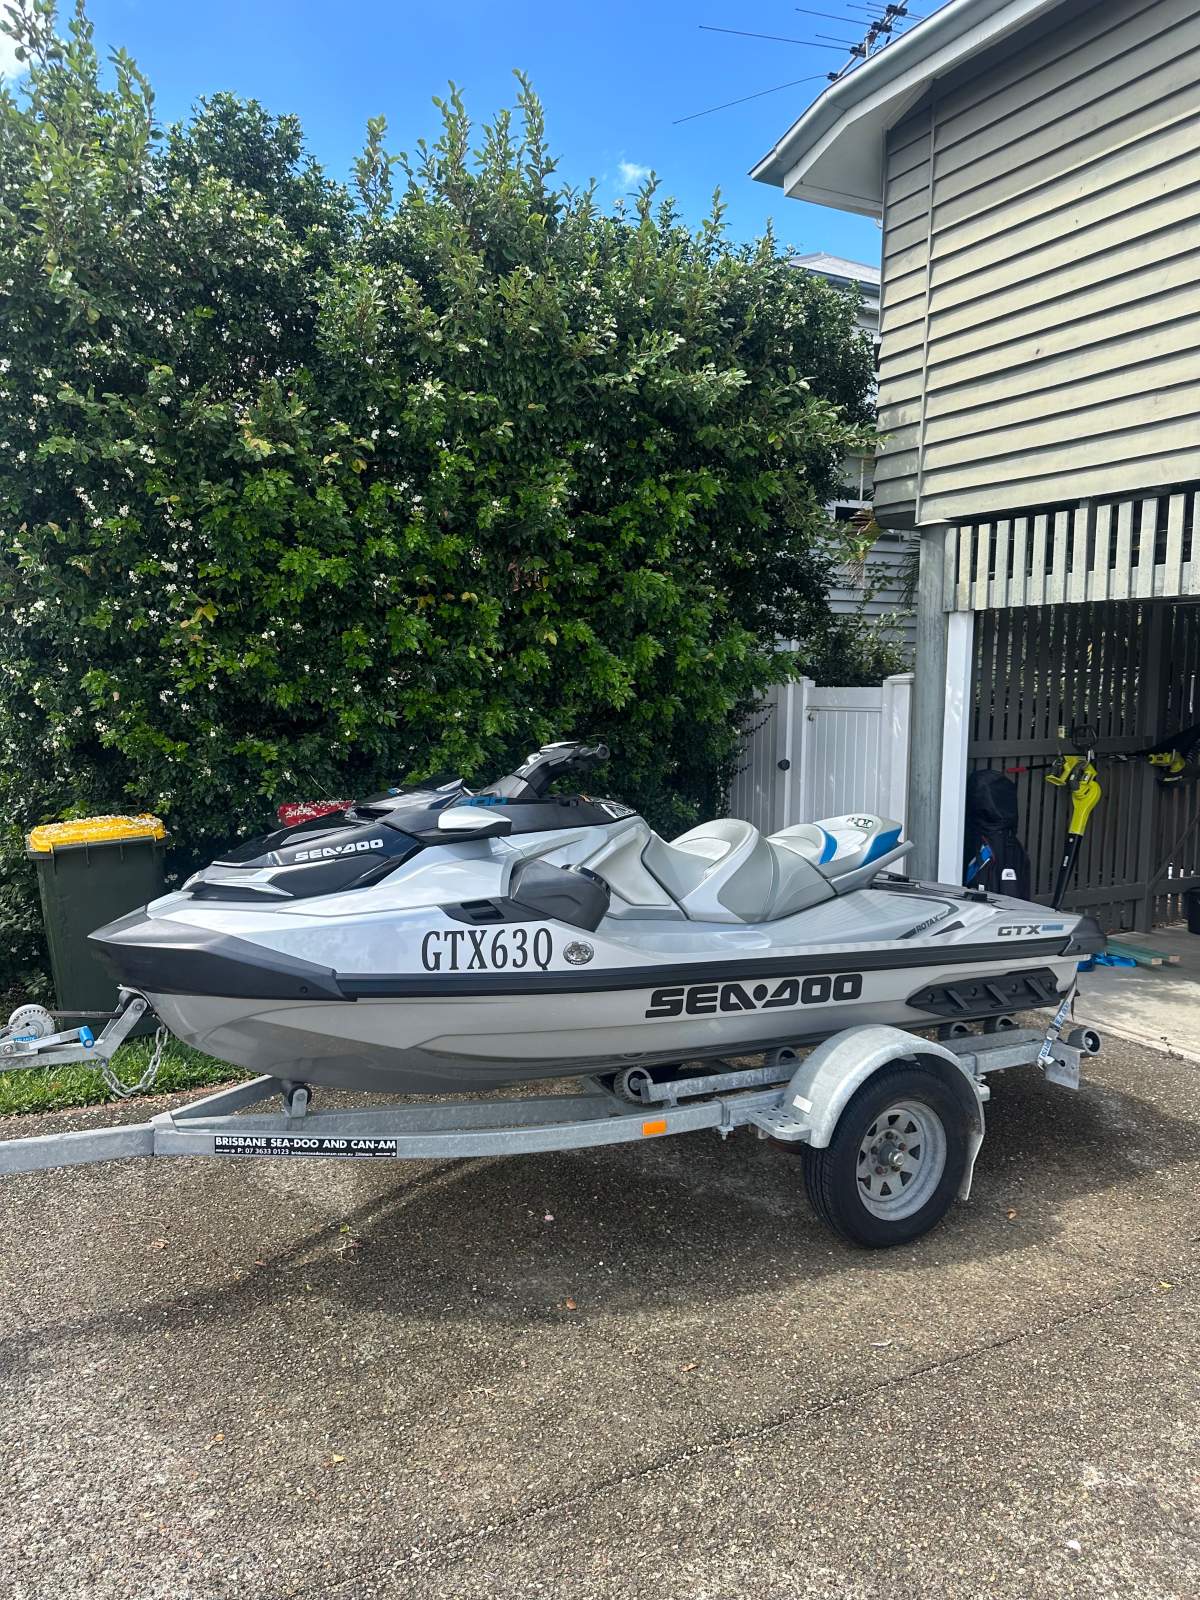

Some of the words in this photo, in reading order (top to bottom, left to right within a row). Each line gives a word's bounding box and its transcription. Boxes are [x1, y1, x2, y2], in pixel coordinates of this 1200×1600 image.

[915, 915, 940, 934] ROTAX
[998, 924, 1041, 937] GTX
[421, 927, 553, 971] GTX63Q
[215, 1136, 267, 1147] BRISBANE
[270, 1138, 319, 1148] SEA-DOO
[322, 1140, 348, 1149] AND
[350, 1140, 396, 1149] CAN-AM
